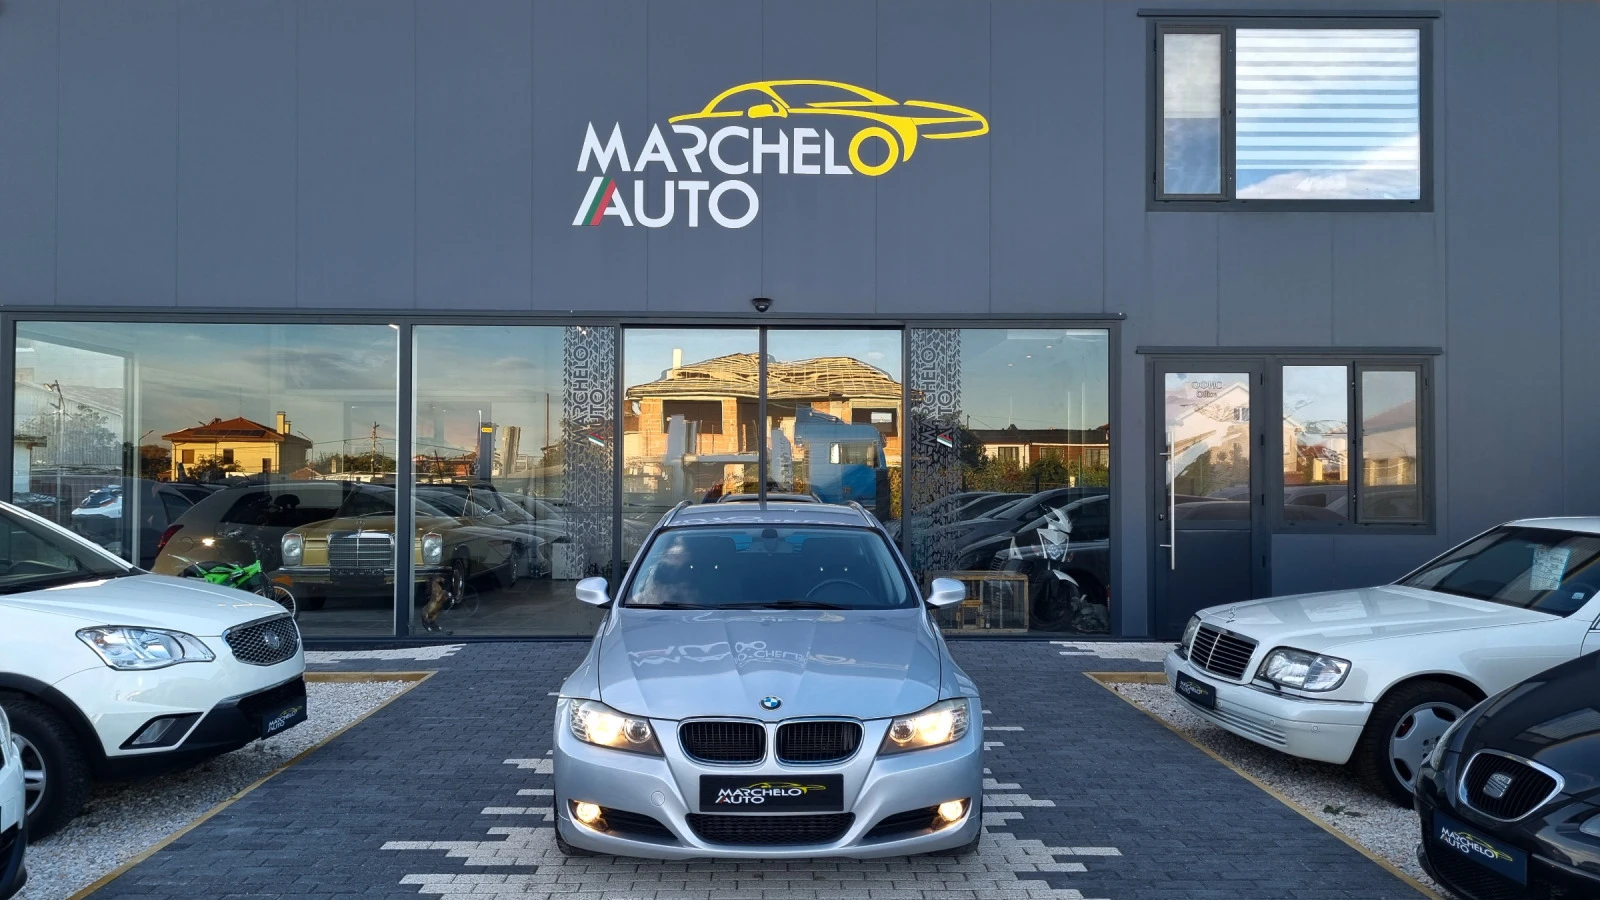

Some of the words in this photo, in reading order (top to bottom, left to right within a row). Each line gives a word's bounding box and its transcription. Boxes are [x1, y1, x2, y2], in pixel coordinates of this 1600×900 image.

[577, 121, 899, 176] MARCHELO
[572, 176, 759, 229] AUTO
[573, 345, 589, 445] MARCHELO
[920, 347, 937, 447] MARCHELO
[715, 796, 765, 804] AUTO
[718, 788, 802, 796] MARCHELO
[1440, 833, 1469, 853] AUTO
[1441, 827, 1495, 858] MARCHELO
